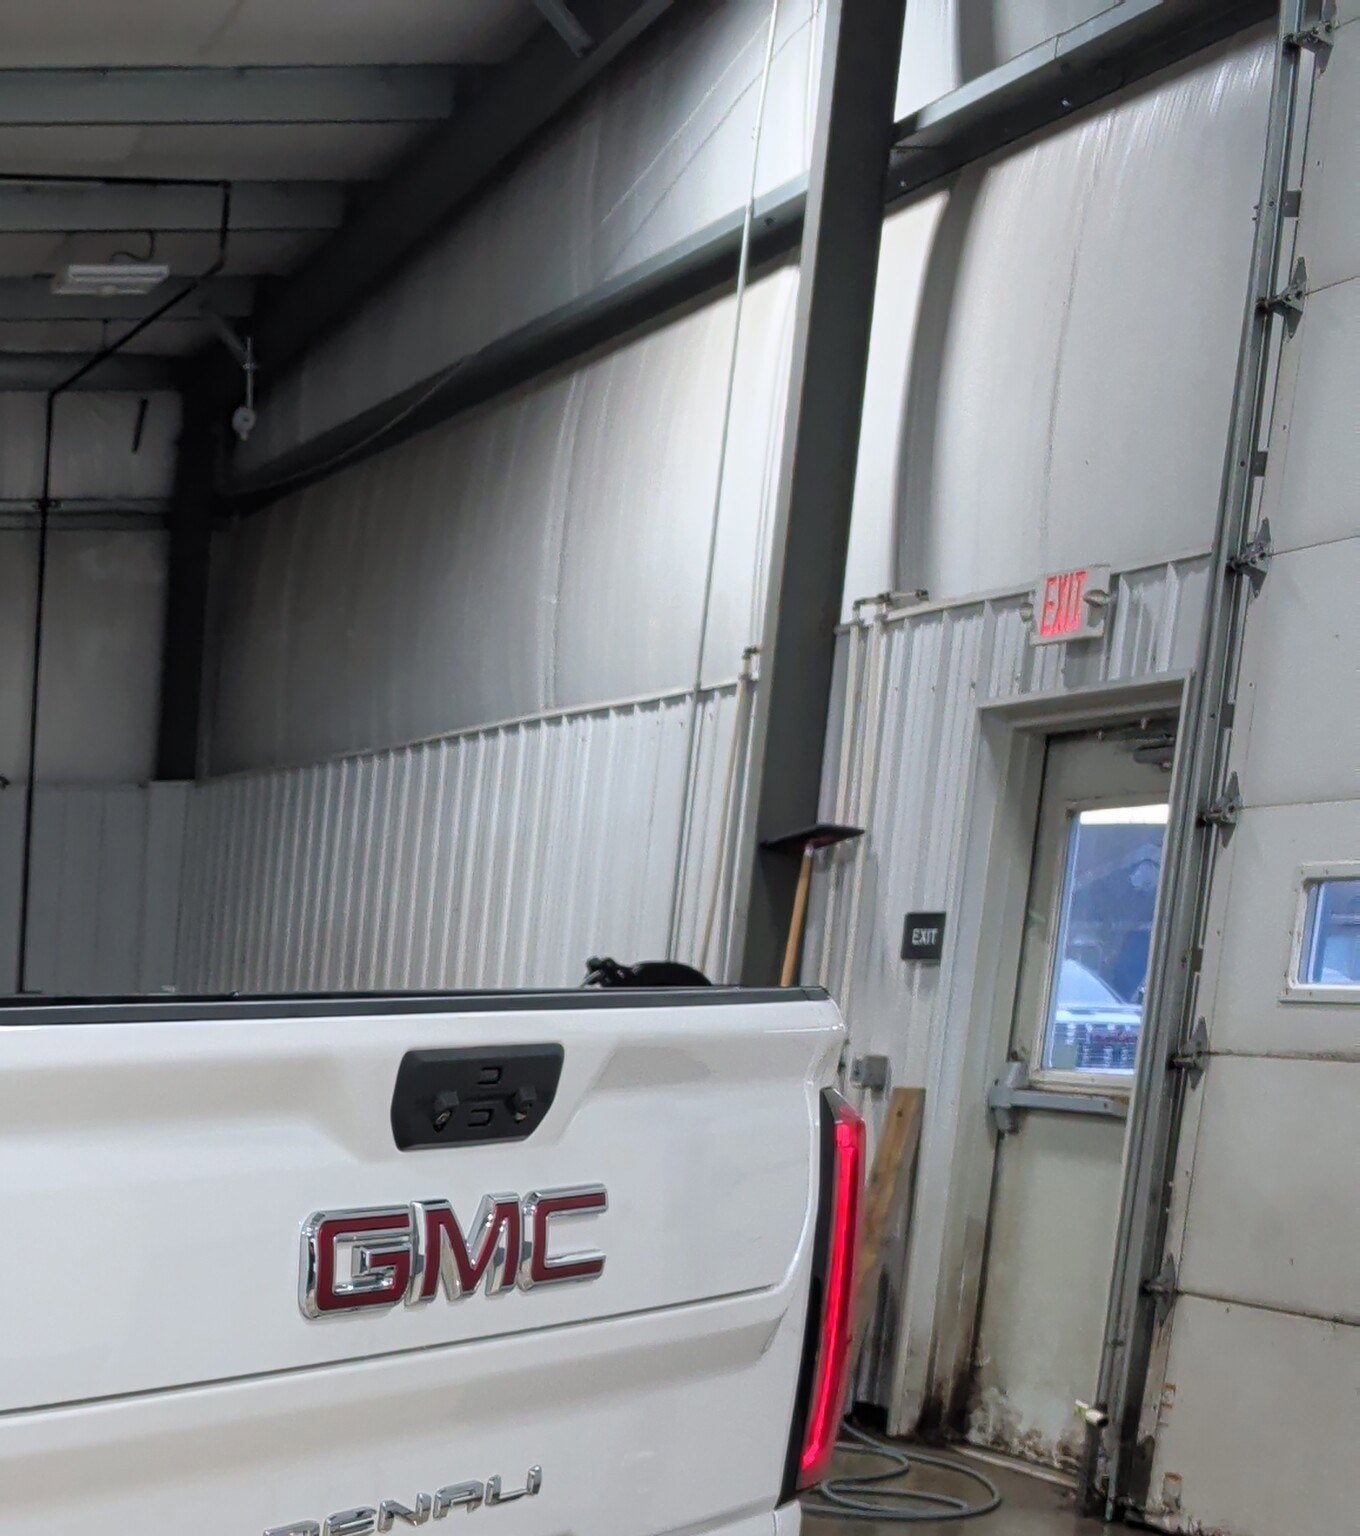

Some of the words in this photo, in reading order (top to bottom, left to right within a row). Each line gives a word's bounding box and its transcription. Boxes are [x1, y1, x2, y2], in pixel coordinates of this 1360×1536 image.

[1040, 569, 1087, 636] EXIT
[912, 928, 938, 945] EXIT
[298, 1182, 609, 1320] GMC
